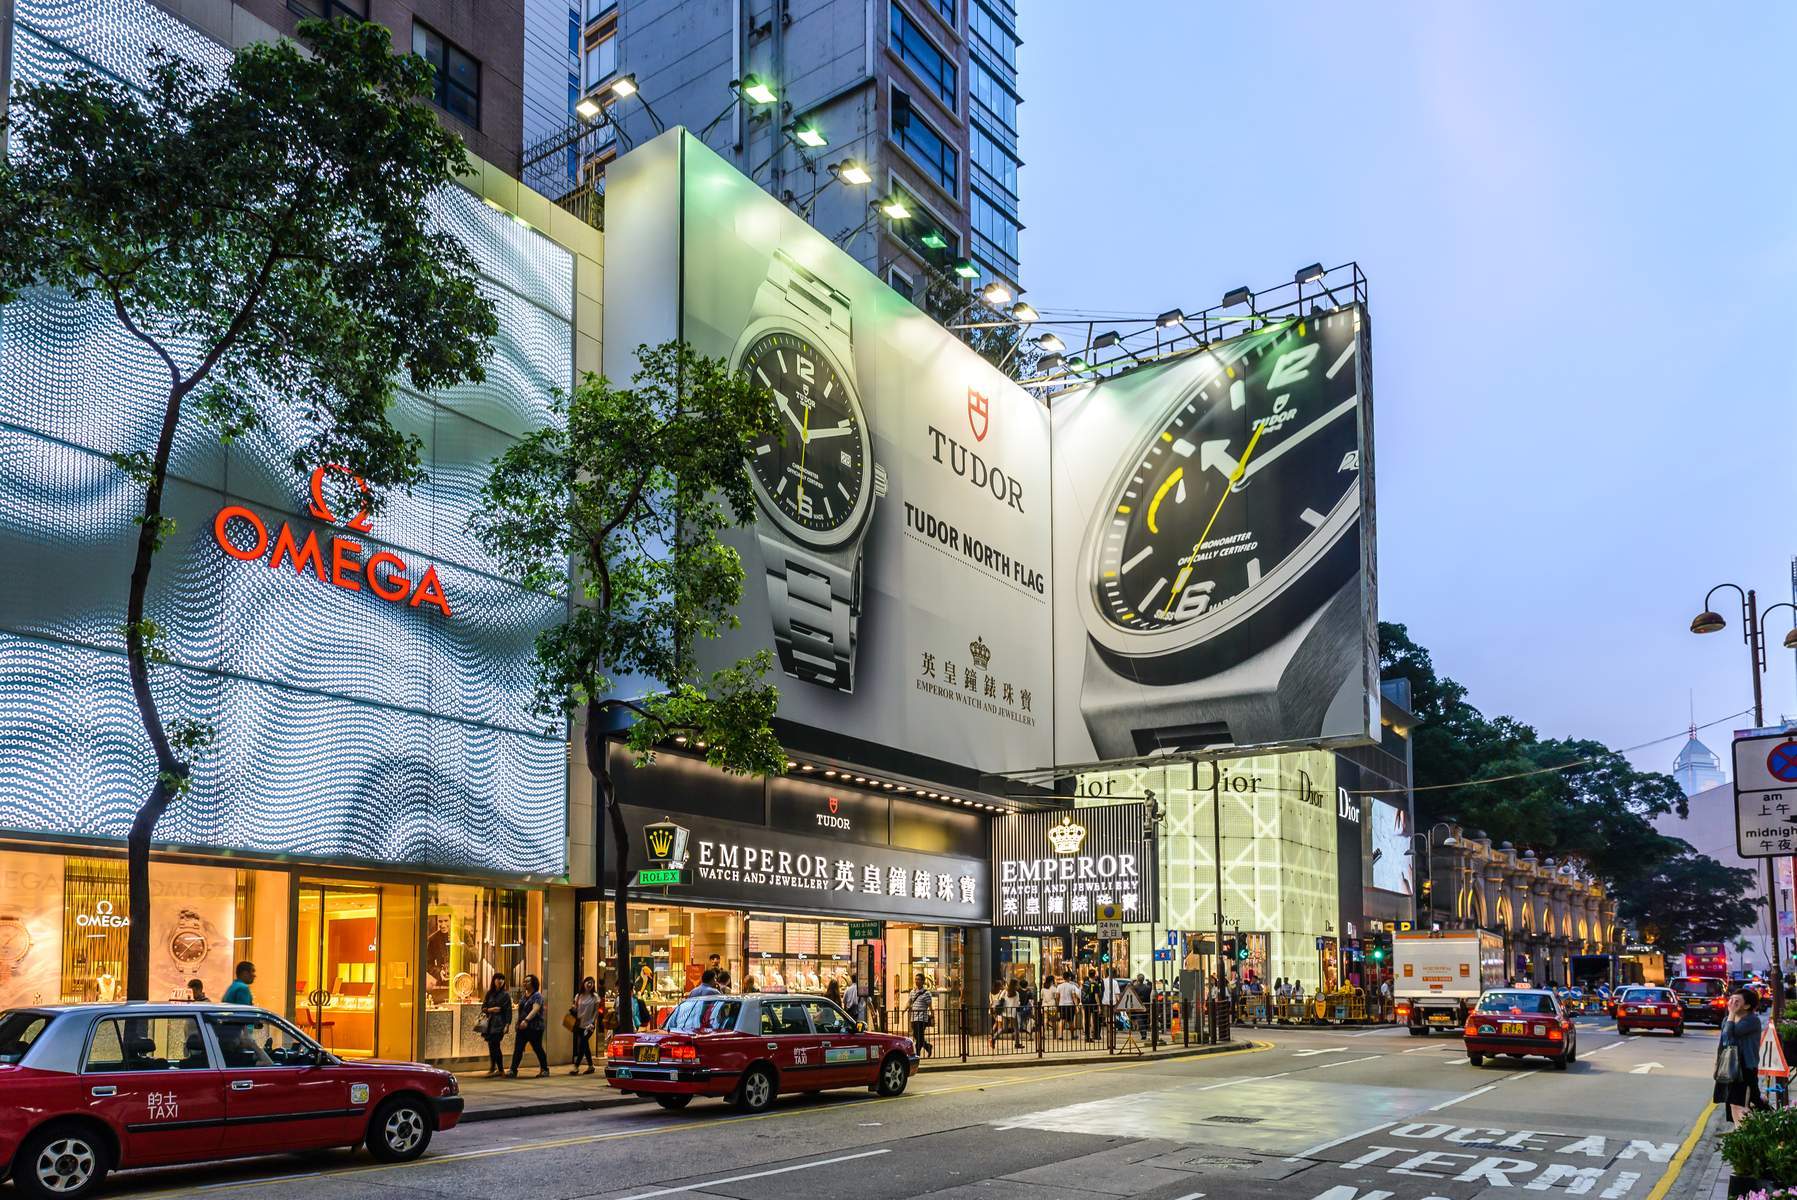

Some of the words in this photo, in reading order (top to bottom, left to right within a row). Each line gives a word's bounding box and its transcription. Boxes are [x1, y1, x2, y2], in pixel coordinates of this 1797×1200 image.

[796, 354, 815, 385] 12
[928, 425, 1024, 514] TUDOR
[904, 501, 959, 551] TUDOR
[963, 533, 1010, 577] NORTH
[1014, 561, 1044, 594] FLAG
[1219, 541, 1259, 556] CERTIFIED
[215, 506, 452, 617] OMEGA
[921, 651, 1032, 712] 英皇鐘錶珠寶
[916, 679, 954, 701] EMPEROR
[955, 692, 982, 709] WATCH
[983, 703, 997, 715] AND
[998, 707, 1036, 727] JEWELLERY
[1078, 774, 1116, 797] ior
[1187, 758, 1262, 793] Dior
[1298, 769, 1323, 808] Dior
[1338, 786, 1360, 823] Dior
[1758, 803, 1790, 816] 上午
[1763, 793, 1782, 802] am
[816, 813, 850, 830] TUDOR
[1760, 838, 1792, 852] 午夜
[699, 841, 829, 879] EMPEROR
[1001, 854, 1139, 883] EMPEROR
[642, 872, 677, 883] ROLEX
[699, 867, 740, 882] WATCH
[743, 873, 766, 884] AND
[769, 874, 829, 890] JEWELLERY
[834, 859, 976, 905] 英皇鐘錶珠寶
[1002, 885, 1039, 895] WATCH
[1044, 884, 1067, 893] AND
[1072, 881, 1139, 892] JEWELLERY
[76, 914, 131, 928] OMEGA
[1213, 912, 1240, 926] Dior
[794, 1055, 808, 1064] TAXI
[147, 1091, 177, 1106] 的士
[147, 1105, 179, 1119] TAXI
[1389, 1122, 1680, 1163] OCEAN
[1339, 1145, 1642, 1199] TERMI
